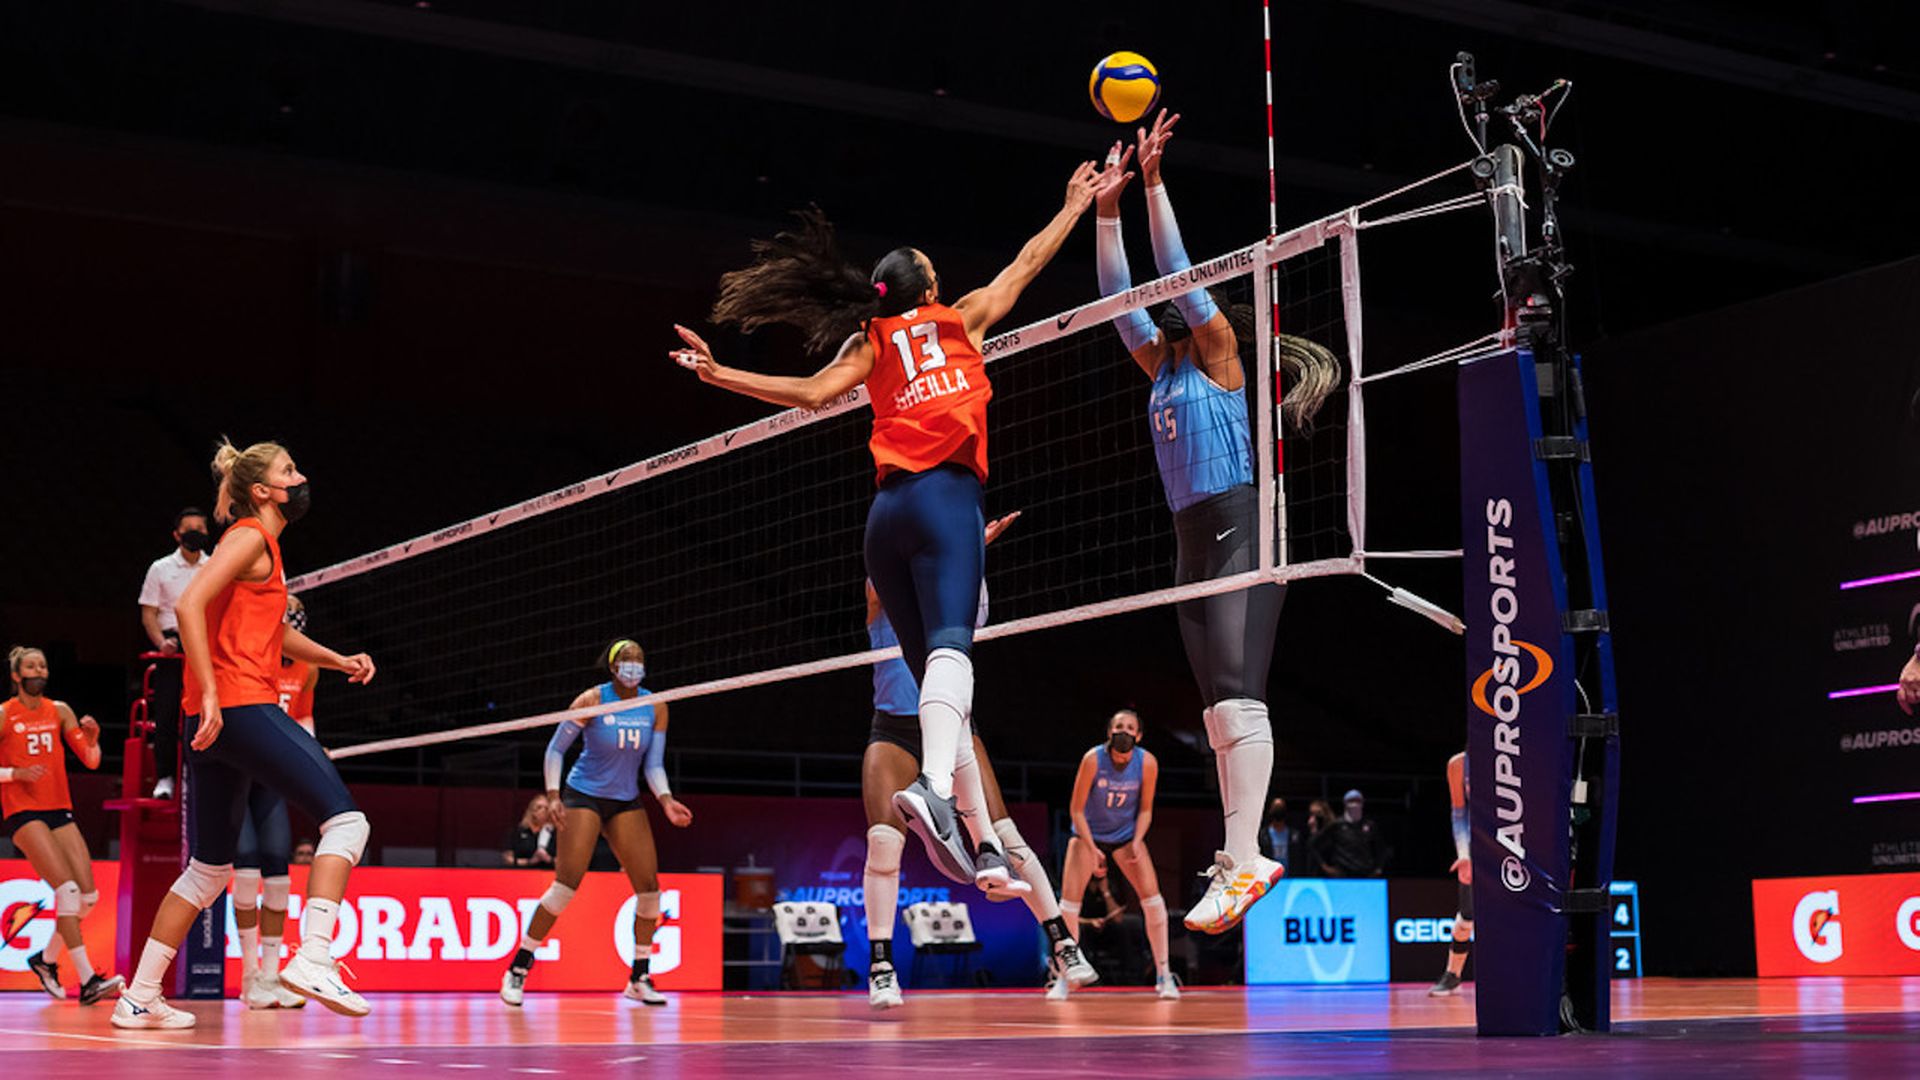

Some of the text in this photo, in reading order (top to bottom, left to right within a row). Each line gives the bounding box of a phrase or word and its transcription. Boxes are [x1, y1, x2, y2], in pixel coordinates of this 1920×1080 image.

[1124, 271, 1187, 305] ATHLETES
[891, 321, 946, 381] 13
[981, 332, 1021, 356] SPORTS
[1486, 497, 1532, 892] @AUPROSPORTS
[26, 732, 53, 755] 29
[617, 727, 640, 750] 14
[1106, 791, 1128, 808] 17
[1614, 903, 1630, 926] 4
[1285, 917, 1356, 944] BLUE
[1394, 918, 1475, 943] GEIC
[1615, 947, 1631, 971] 2
